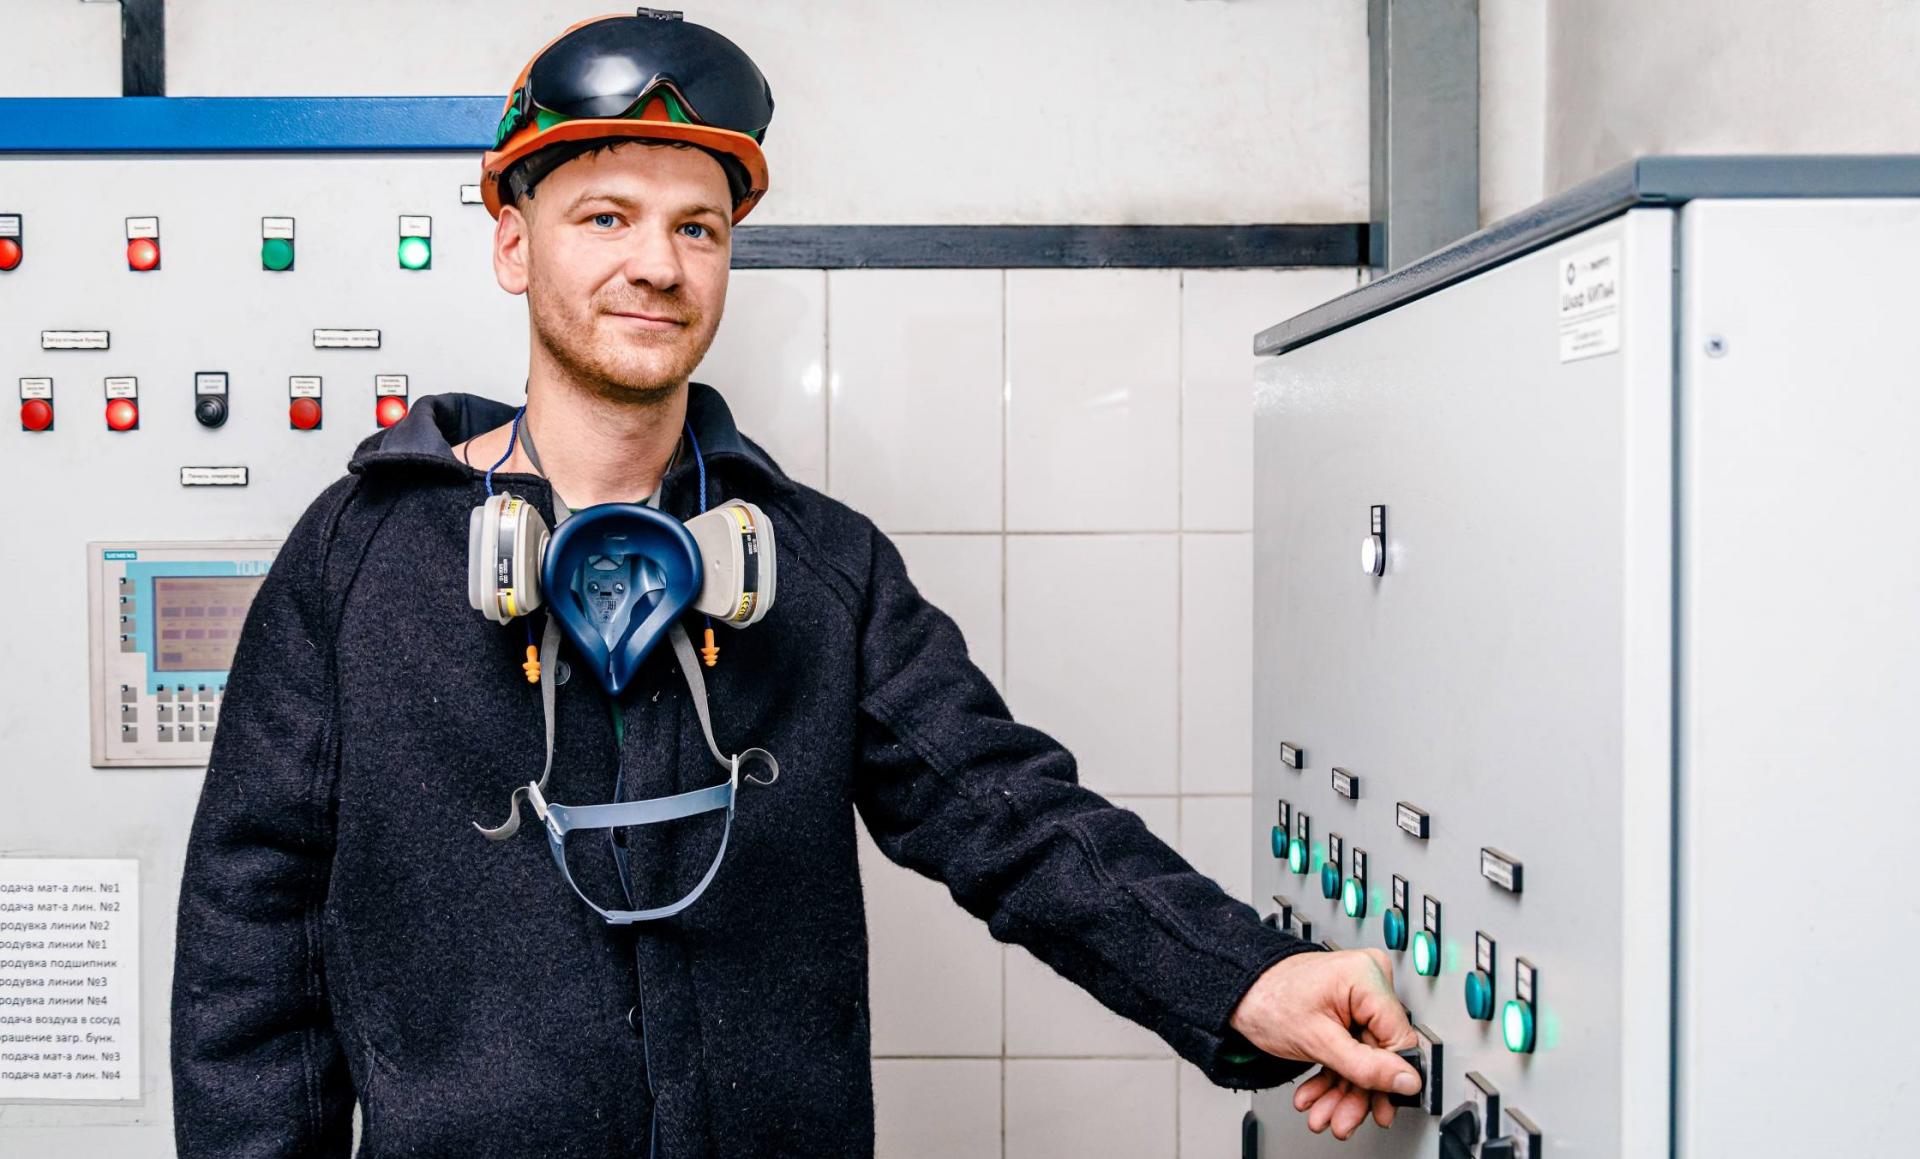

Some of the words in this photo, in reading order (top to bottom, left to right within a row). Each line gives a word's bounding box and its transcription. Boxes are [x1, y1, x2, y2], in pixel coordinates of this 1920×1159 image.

[0, 884, 34, 893] одача
[37, 884, 69, 893] мат-а
[71, 884, 97, 893] лин.
[100, 882, 120, 893] №1
[0, 903, 34, 912] одача
[37, 903, 69, 912] мат-а
[71, 903, 97, 912] лин.
[100, 901, 120, 912] №2
[0, 922, 47, 931] родувка
[50, 922, 87, 931] линии
[89, 920, 110, 931] №2
[47, 941, 84, 950] линии
[86, 939, 107, 950] №1
[0, 959, 47, 969] родувка
[49, 959, 118, 969] подшипник
[47, 978, 84, 987] линии
[86, 976, 108, 987] №3
[47, 997, 84, 1006] линии
[86, 995, 108, 1006] №4
[0, 1016, 33, 1025] одача
[35, 1016, 79, 1026] воздуха
[80, 1016, 88, 1024] в
[89, 1016, 121, 1026] сосуд
[55, 1034, 84, 1044] загр.
[86, 1032, 116, 1044] бунк.
[1, 1052, 40, 1062] подача
[42, 1052, 73, 1061] мат-а
[75, 1052, 98, 1061] лин.
[101, 1051, 121, 1062] №3
[1, 1071, 40, 1081] подача
[42, 1071, 73, 1080] мат-а
[75, 1071, 98, 1080] лин.
[101, 1070, 121, 1080] №4
